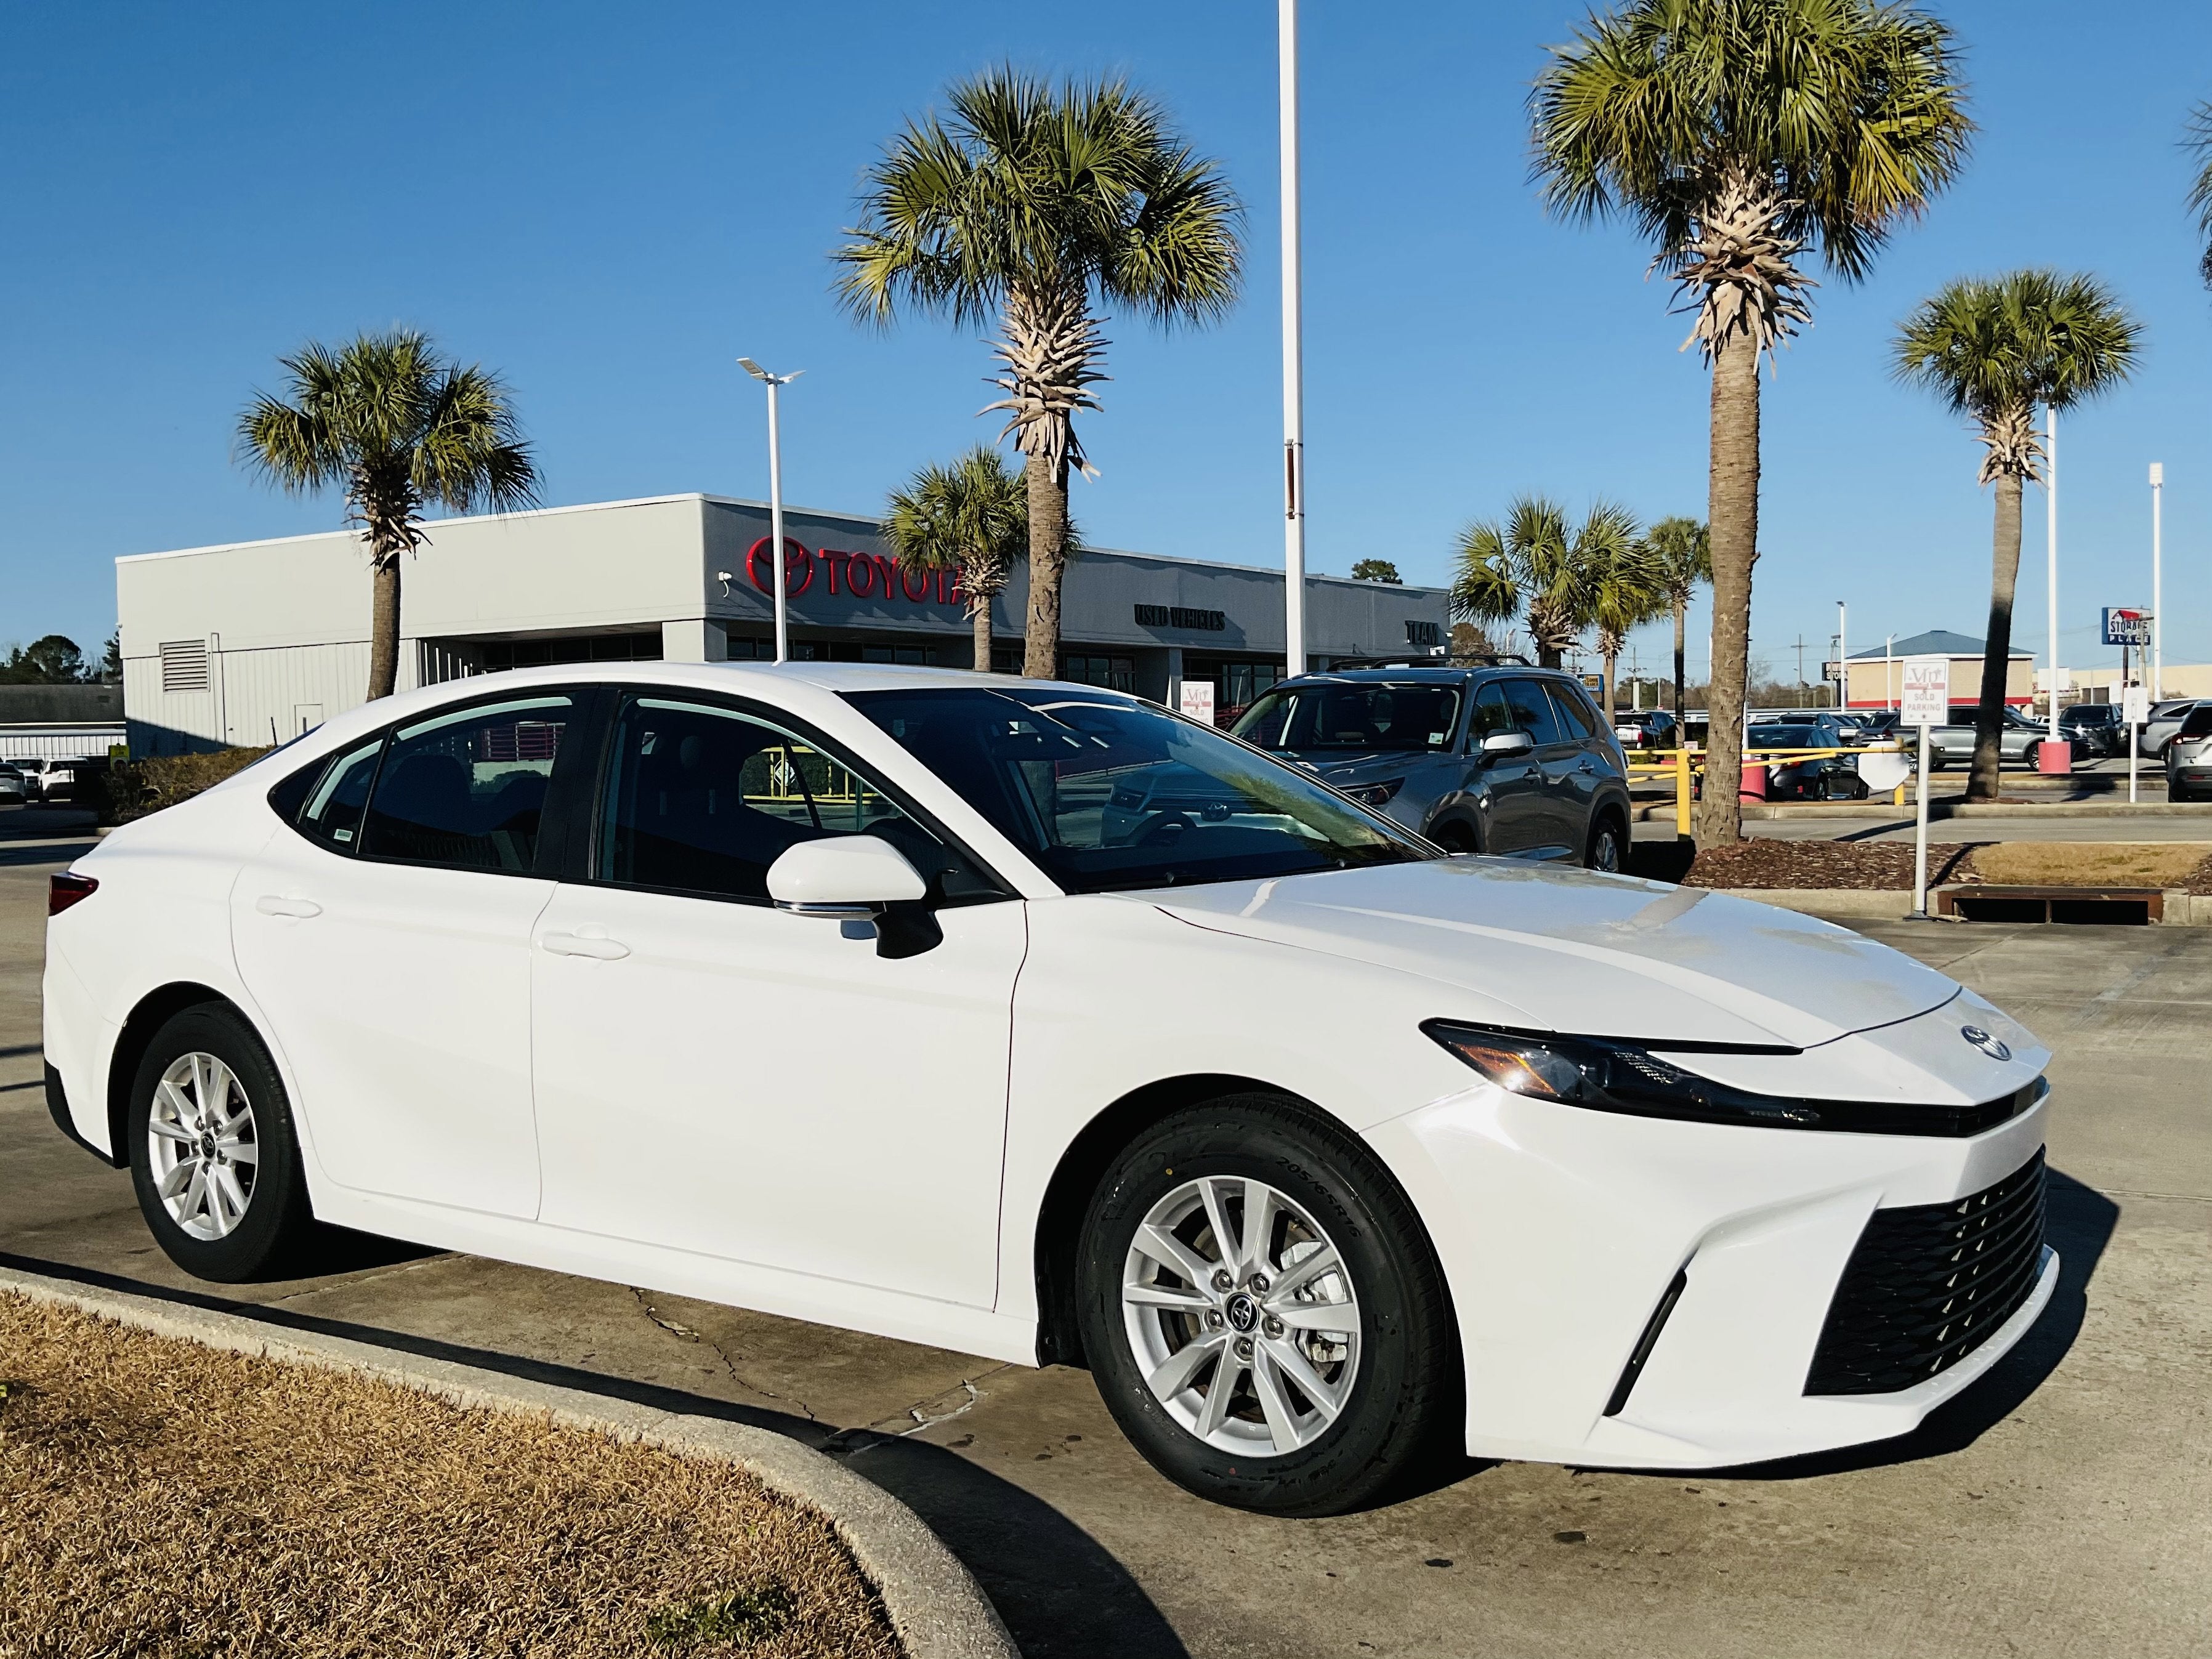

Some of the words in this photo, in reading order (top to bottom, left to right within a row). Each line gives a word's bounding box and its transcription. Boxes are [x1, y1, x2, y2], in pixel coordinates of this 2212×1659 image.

[1134, 604, 1168, 626] USED
[1170, 607, 1225, 631] VEHICLES
[2110, 621, 2148, 632] STORAE
